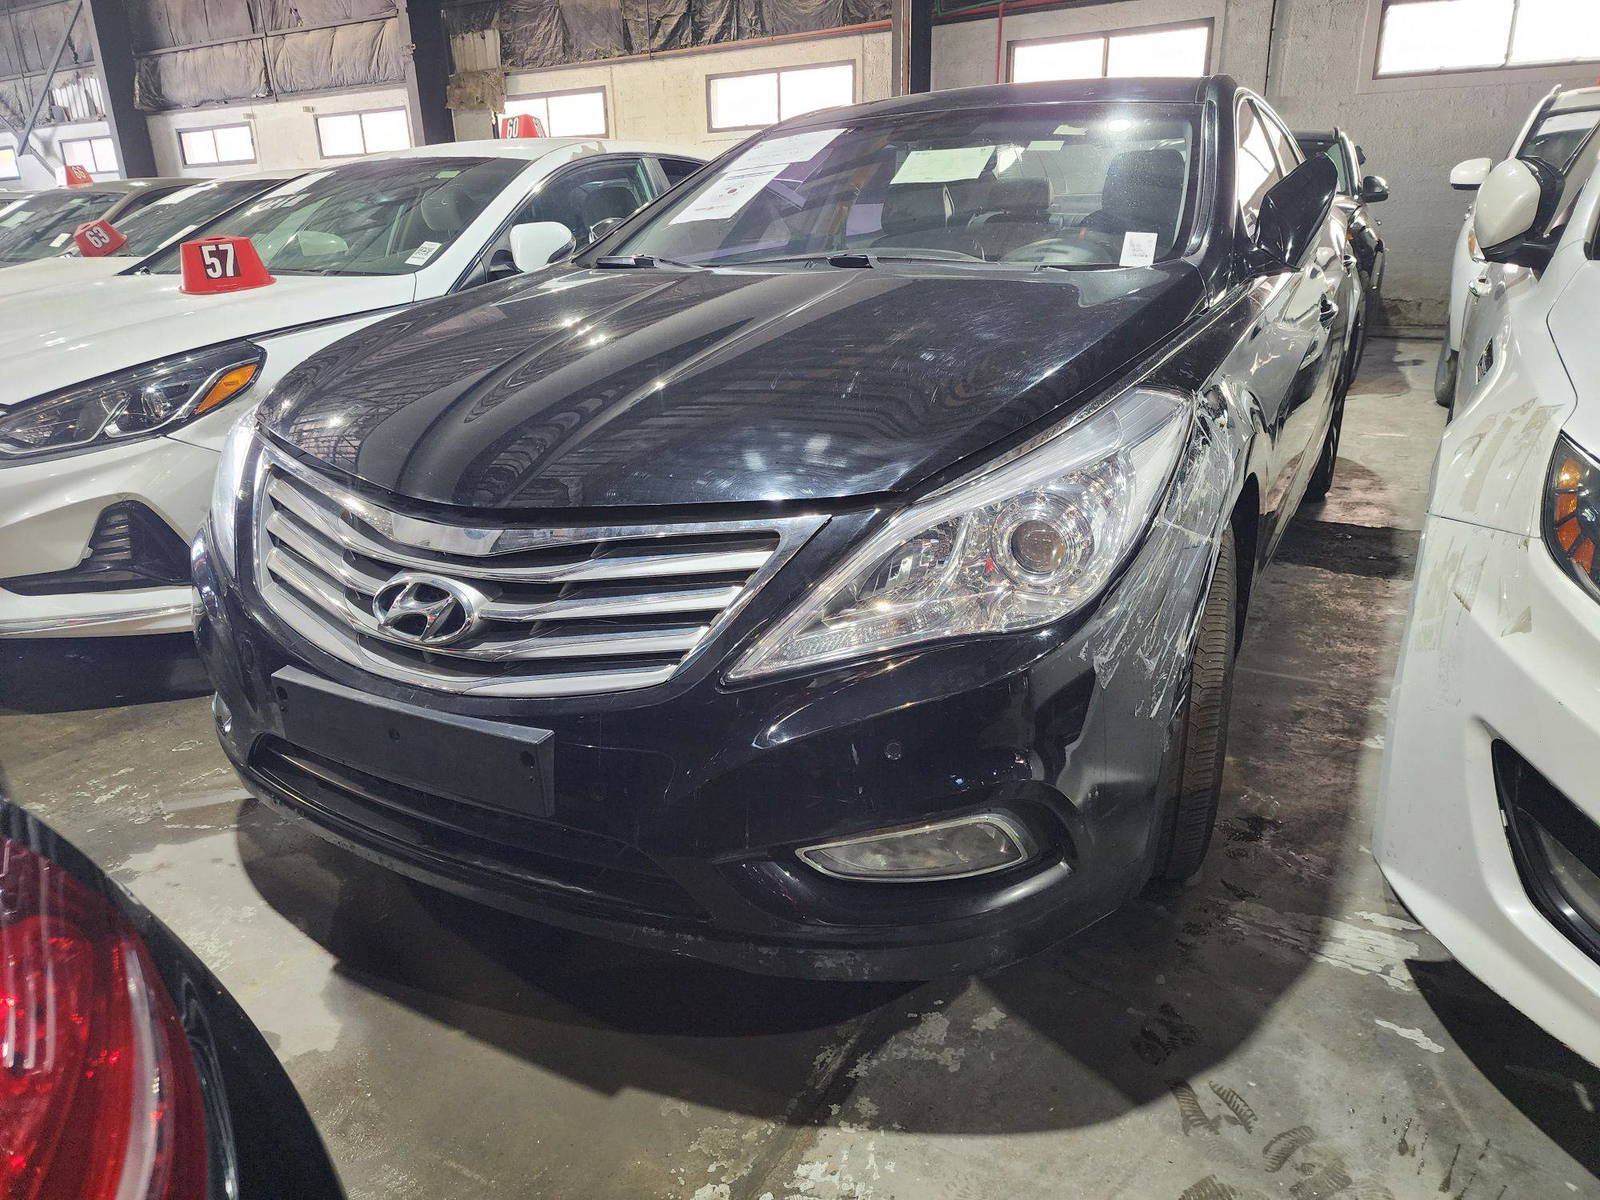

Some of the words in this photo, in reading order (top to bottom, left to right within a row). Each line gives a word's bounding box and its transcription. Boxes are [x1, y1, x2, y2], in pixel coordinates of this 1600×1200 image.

[507, 117, 519, 138] 60
[85, 224, 110, 248] 63
[201, 243, 235, 278] 57
